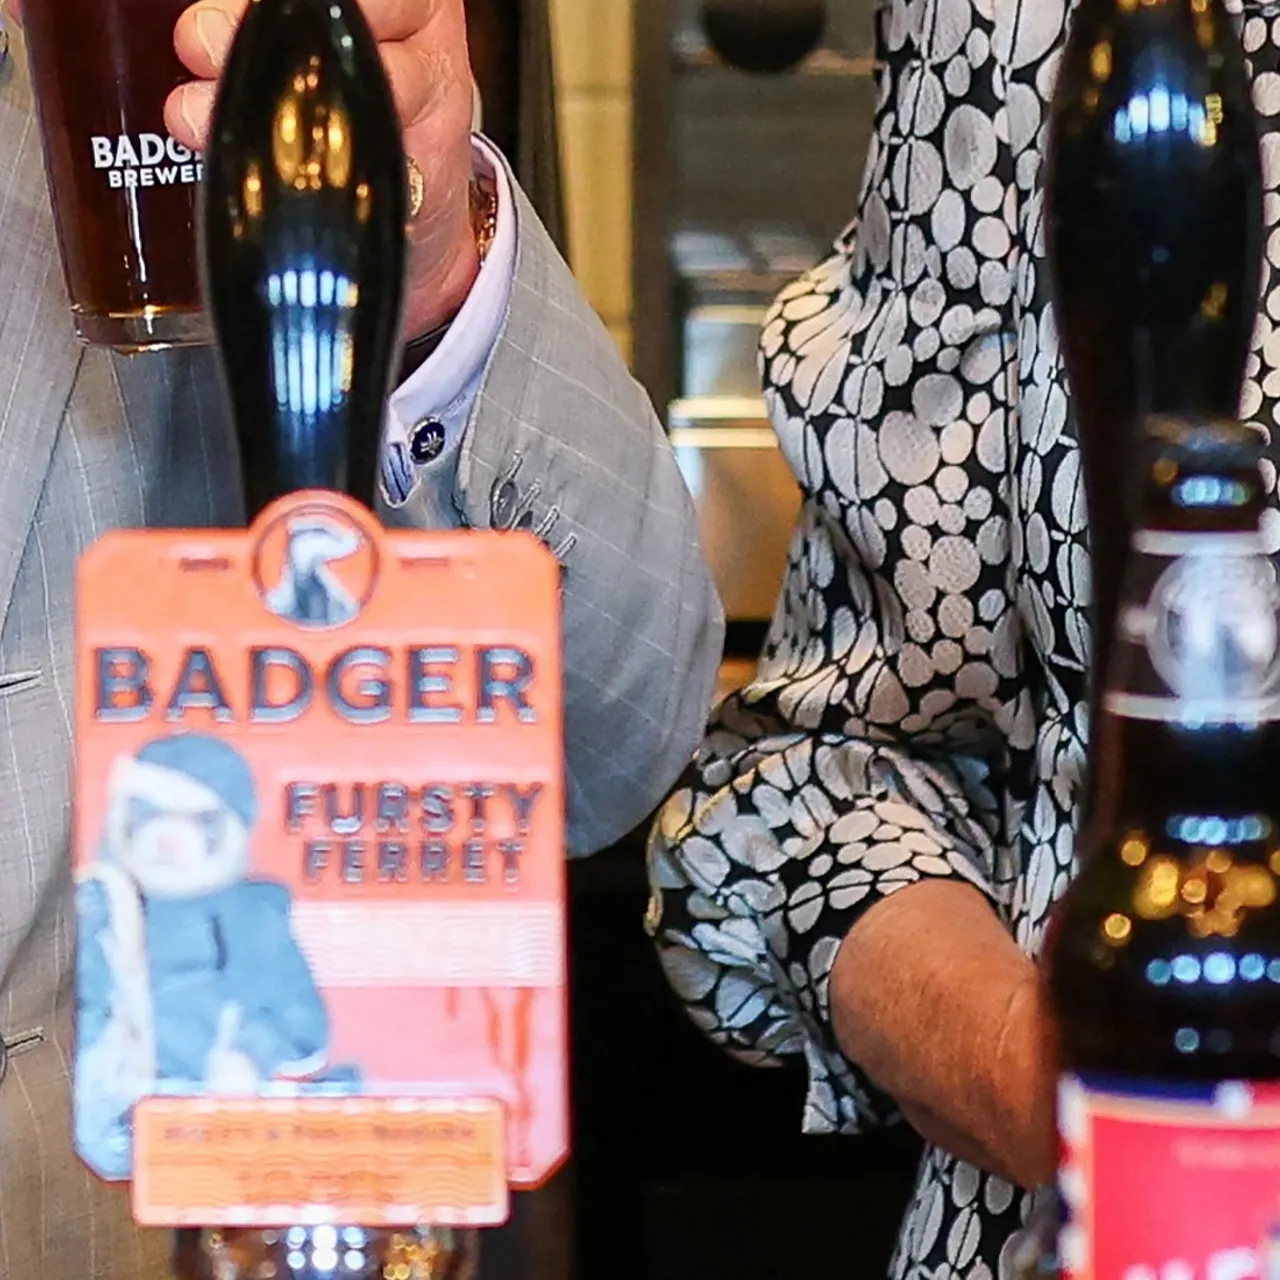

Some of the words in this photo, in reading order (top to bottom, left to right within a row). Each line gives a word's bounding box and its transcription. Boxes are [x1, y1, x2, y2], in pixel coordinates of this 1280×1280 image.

[91, 133, 203, 168] BADG
[109, 163, 203, 188] BREWE
[94, 644, 537, 725] BADGER
[284, 781, 542, 836] FURSTY
[303, 840, 524, 885] FERRET
